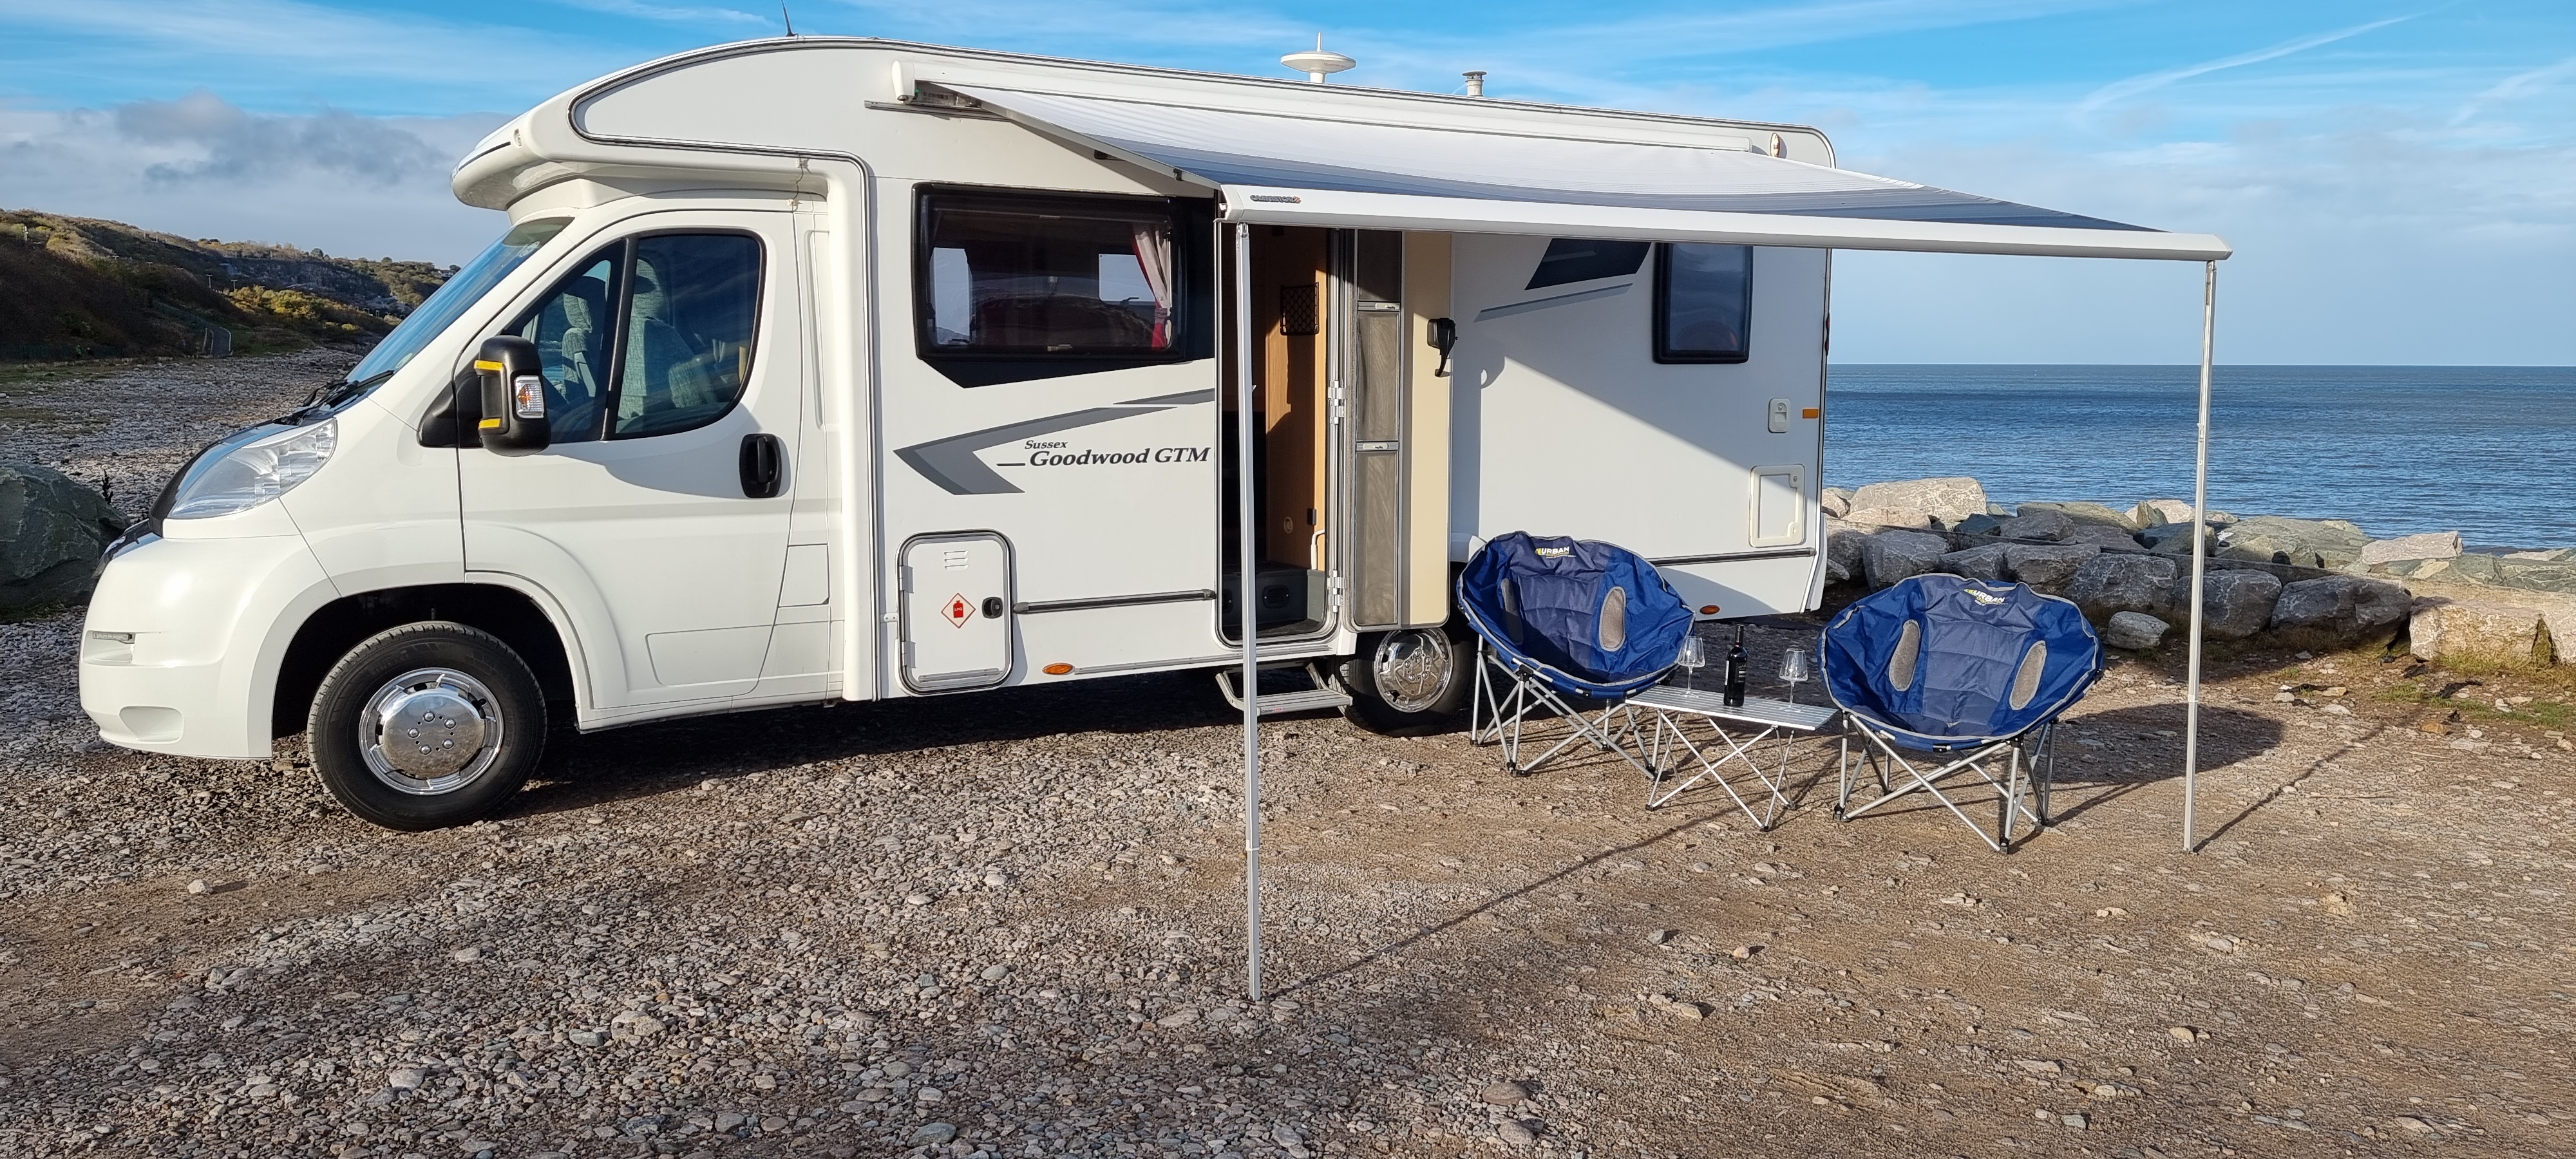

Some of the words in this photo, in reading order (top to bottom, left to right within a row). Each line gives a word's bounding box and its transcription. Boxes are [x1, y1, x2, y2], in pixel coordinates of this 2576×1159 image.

[1024, 440, 1068, 449] Sussex
[1030, 448, 1151, 467] Goodwood
[1154, 447, 1211, 463] GTM
[1973, 590, 2005, 603] URBAN
